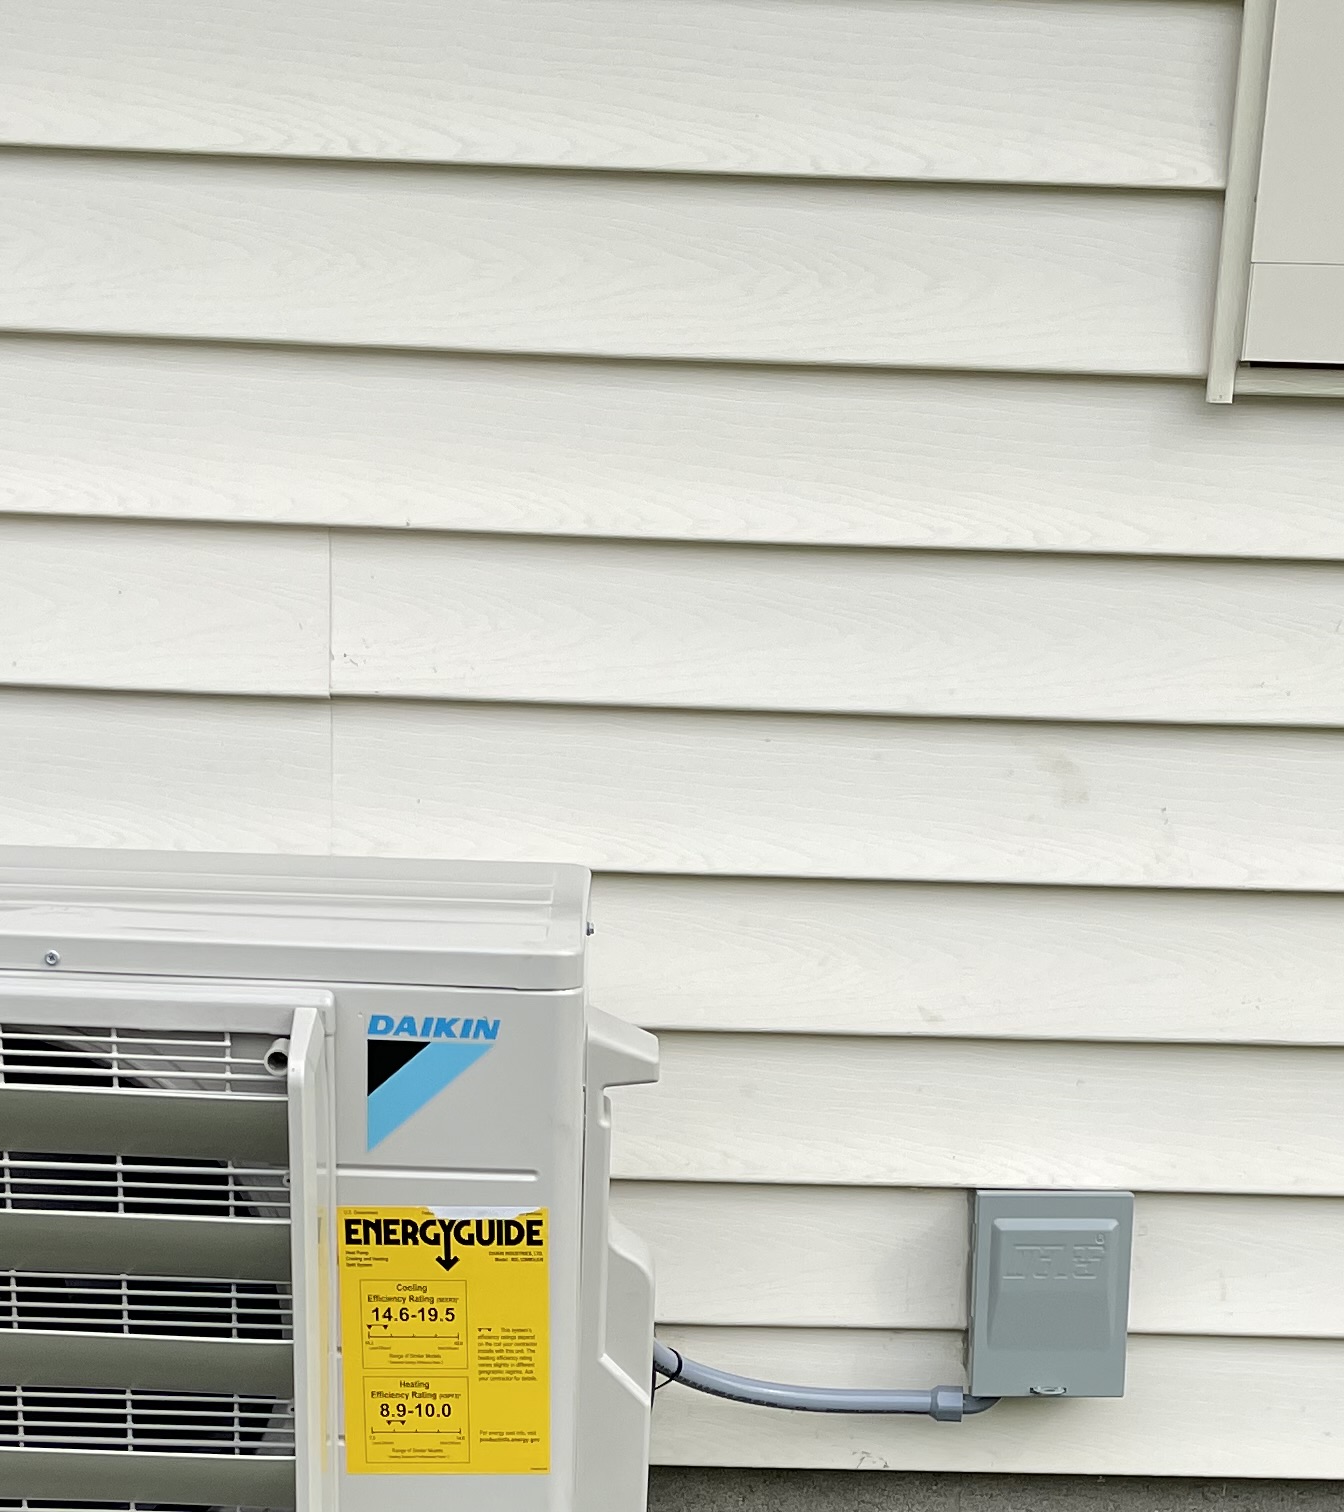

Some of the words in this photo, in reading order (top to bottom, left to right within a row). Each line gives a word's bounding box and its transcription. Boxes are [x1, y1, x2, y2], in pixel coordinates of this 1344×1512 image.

[367, 1014, 501, 1040] DAIKIN
[344, 1218, 544, 1247] ENERGYGUIDE
[396, 1283, 428, 1294] Cooling
[367, 1294, 407, 1305] Efficiency
[408, 1294, 435, 1305] Rating
[371, 1306, 456, 1322] 14.6-19.5
[399, 1379, 430, 1390] Heating
[370, 1390, 410, 1401] Efficiency
[411, 1390, 438, 1401] Rating
[379, 1403, 452, 1418] 8.9-10.0
